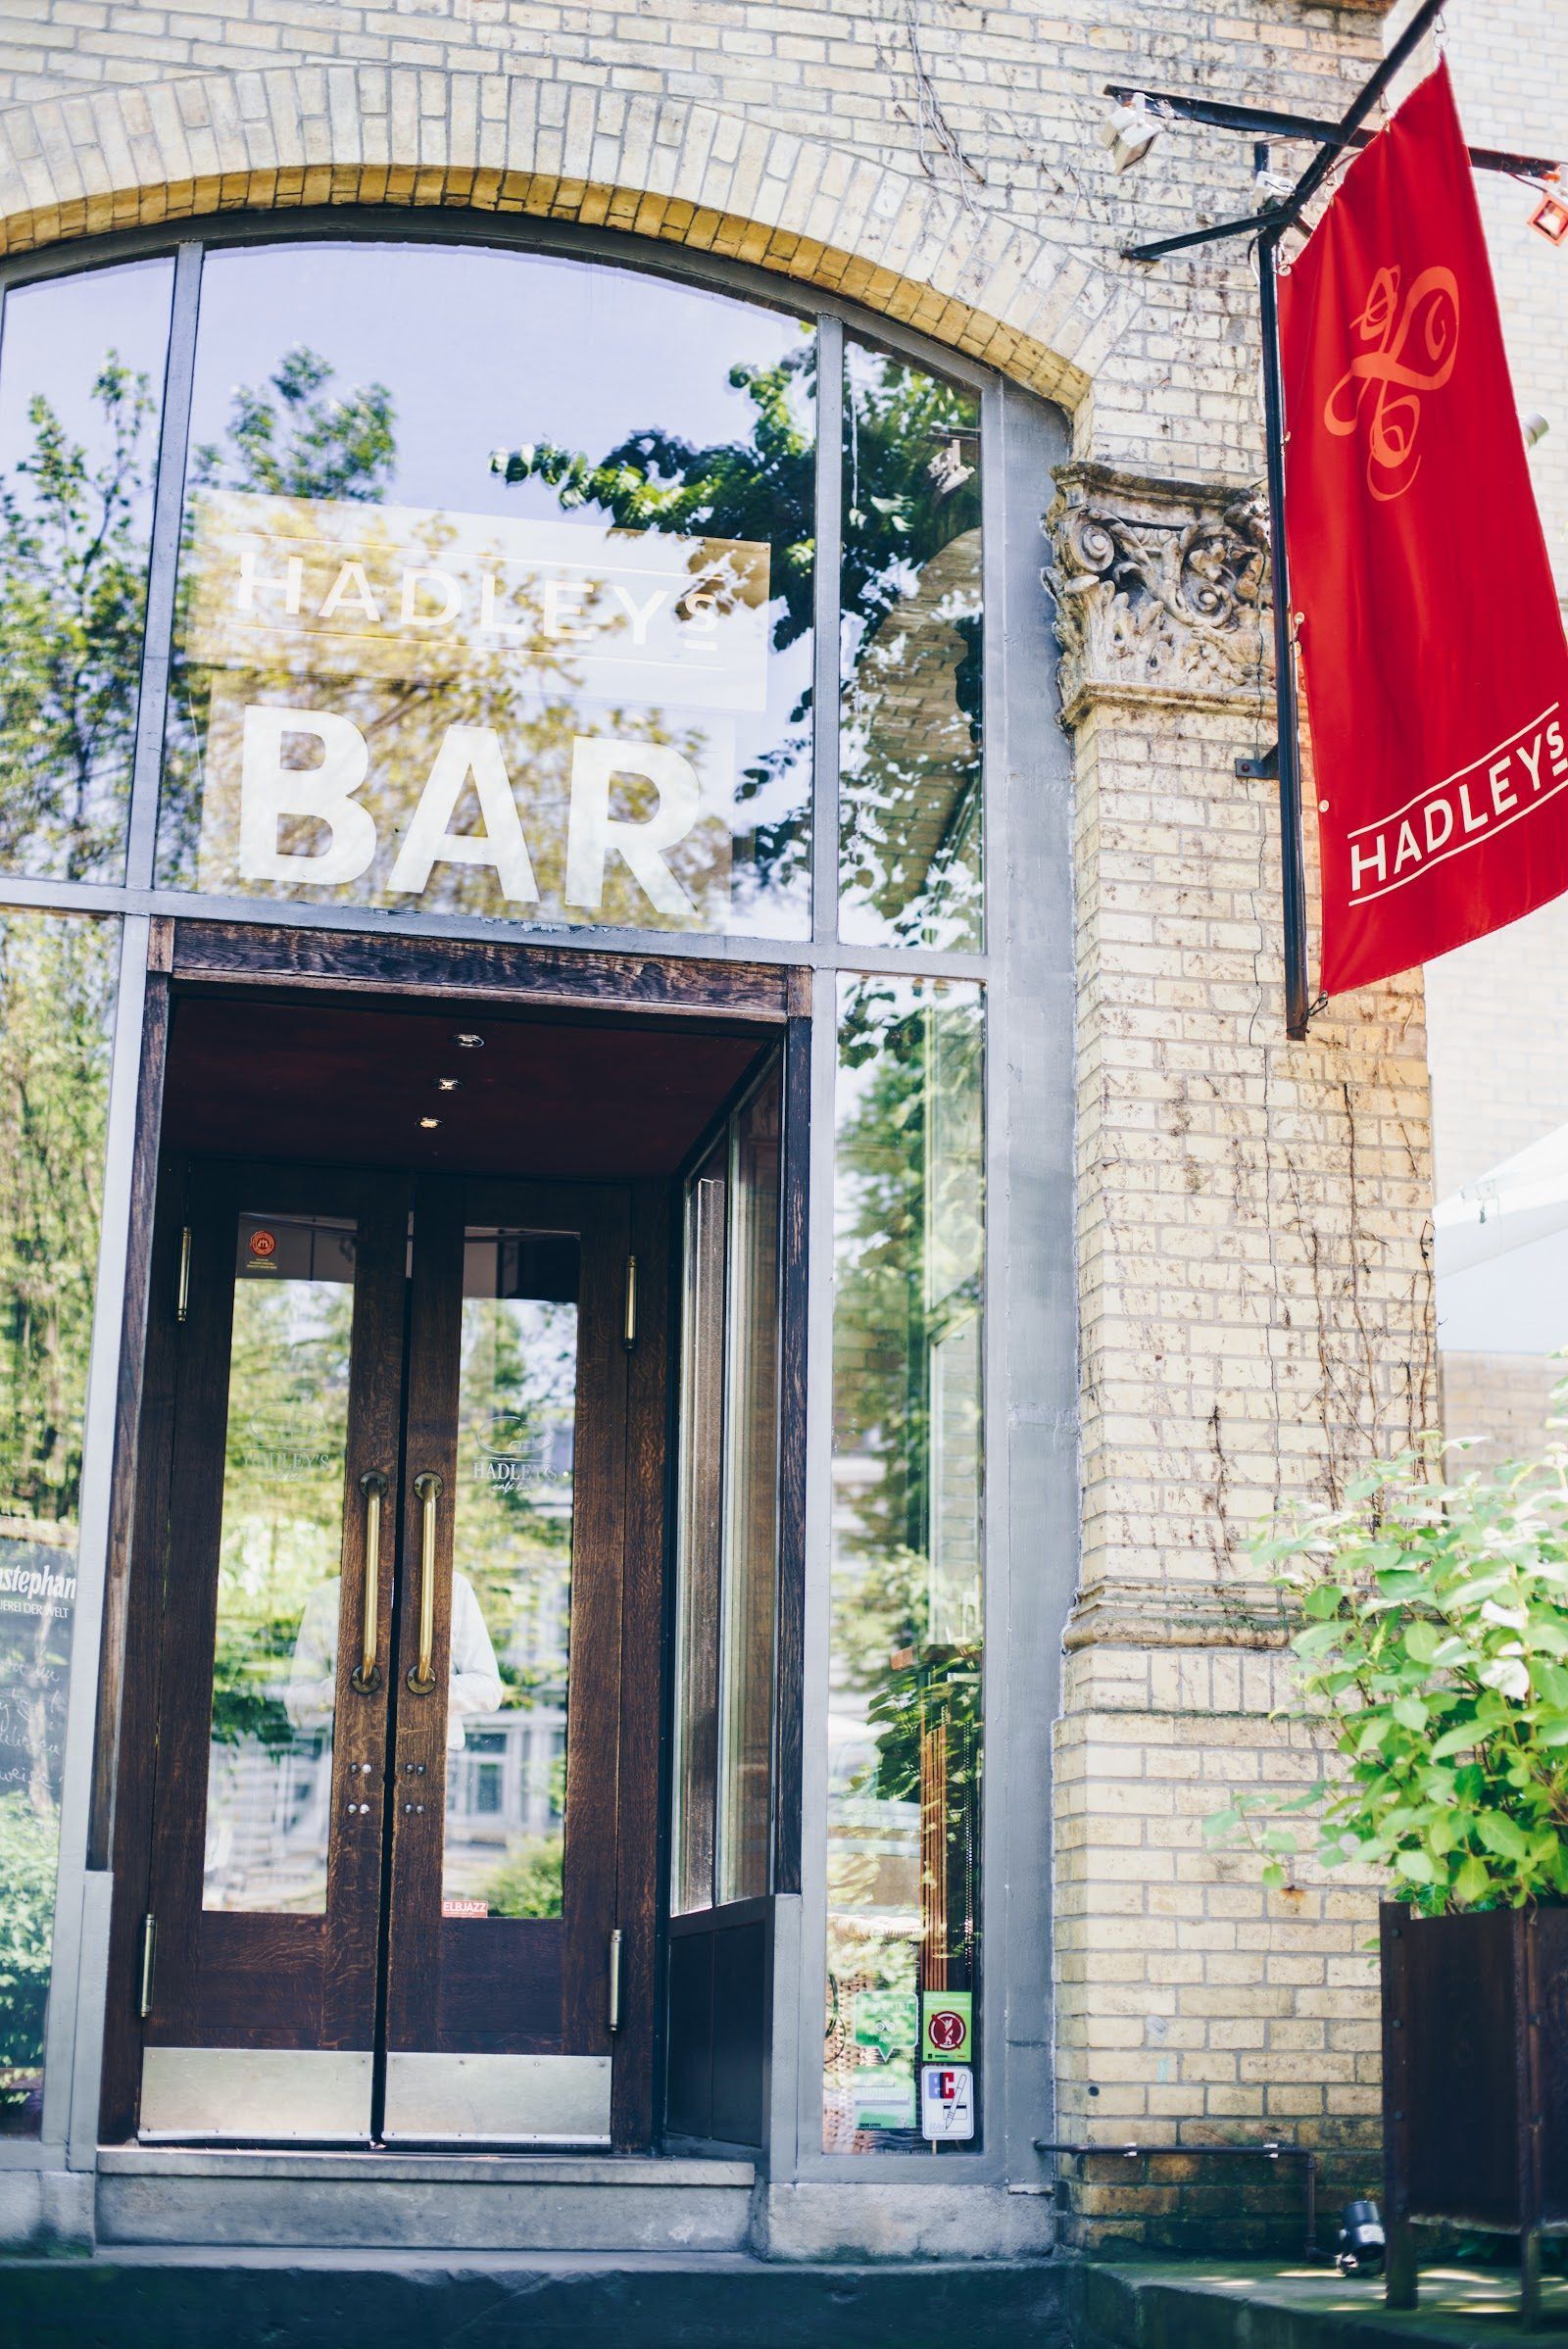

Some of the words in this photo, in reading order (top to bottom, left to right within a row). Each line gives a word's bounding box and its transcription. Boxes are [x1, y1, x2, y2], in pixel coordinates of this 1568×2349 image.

[239, 704, 702, 916] BAR
[0, 1565, 77, 1599] stephan
[443, 1901, 487, 1913] ELBJAZZ
